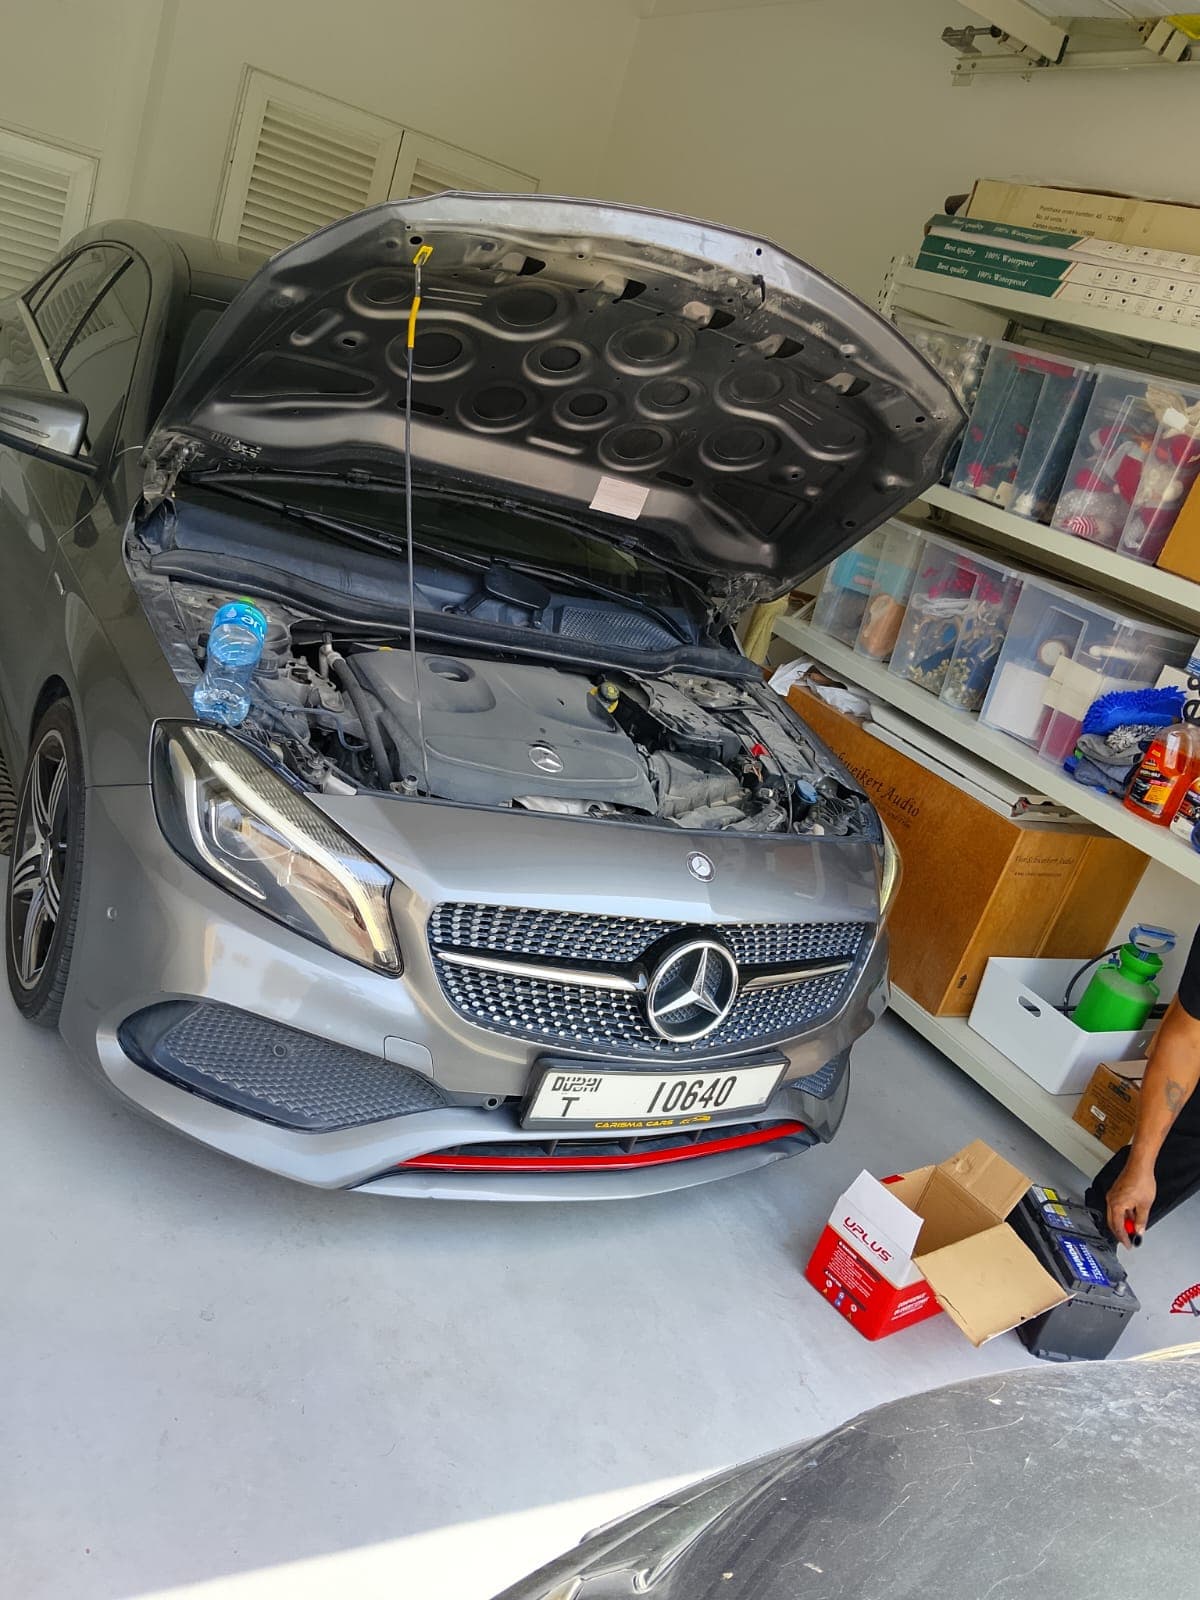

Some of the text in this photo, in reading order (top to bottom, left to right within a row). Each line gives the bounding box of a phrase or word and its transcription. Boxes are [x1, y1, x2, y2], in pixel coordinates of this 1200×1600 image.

[881, 786, 920, 817] Audio
[561, 1096, 581, 1117] T
[646, 1075, 738, 1114] 10640
[594, 1121, 643, 1130] CARISMA
[646, 1120, 674, 1128] CARS
[844, 1216, 892, 1262] UPLUS
[1064, 1240, 1090, 1278] HYUNDAI
